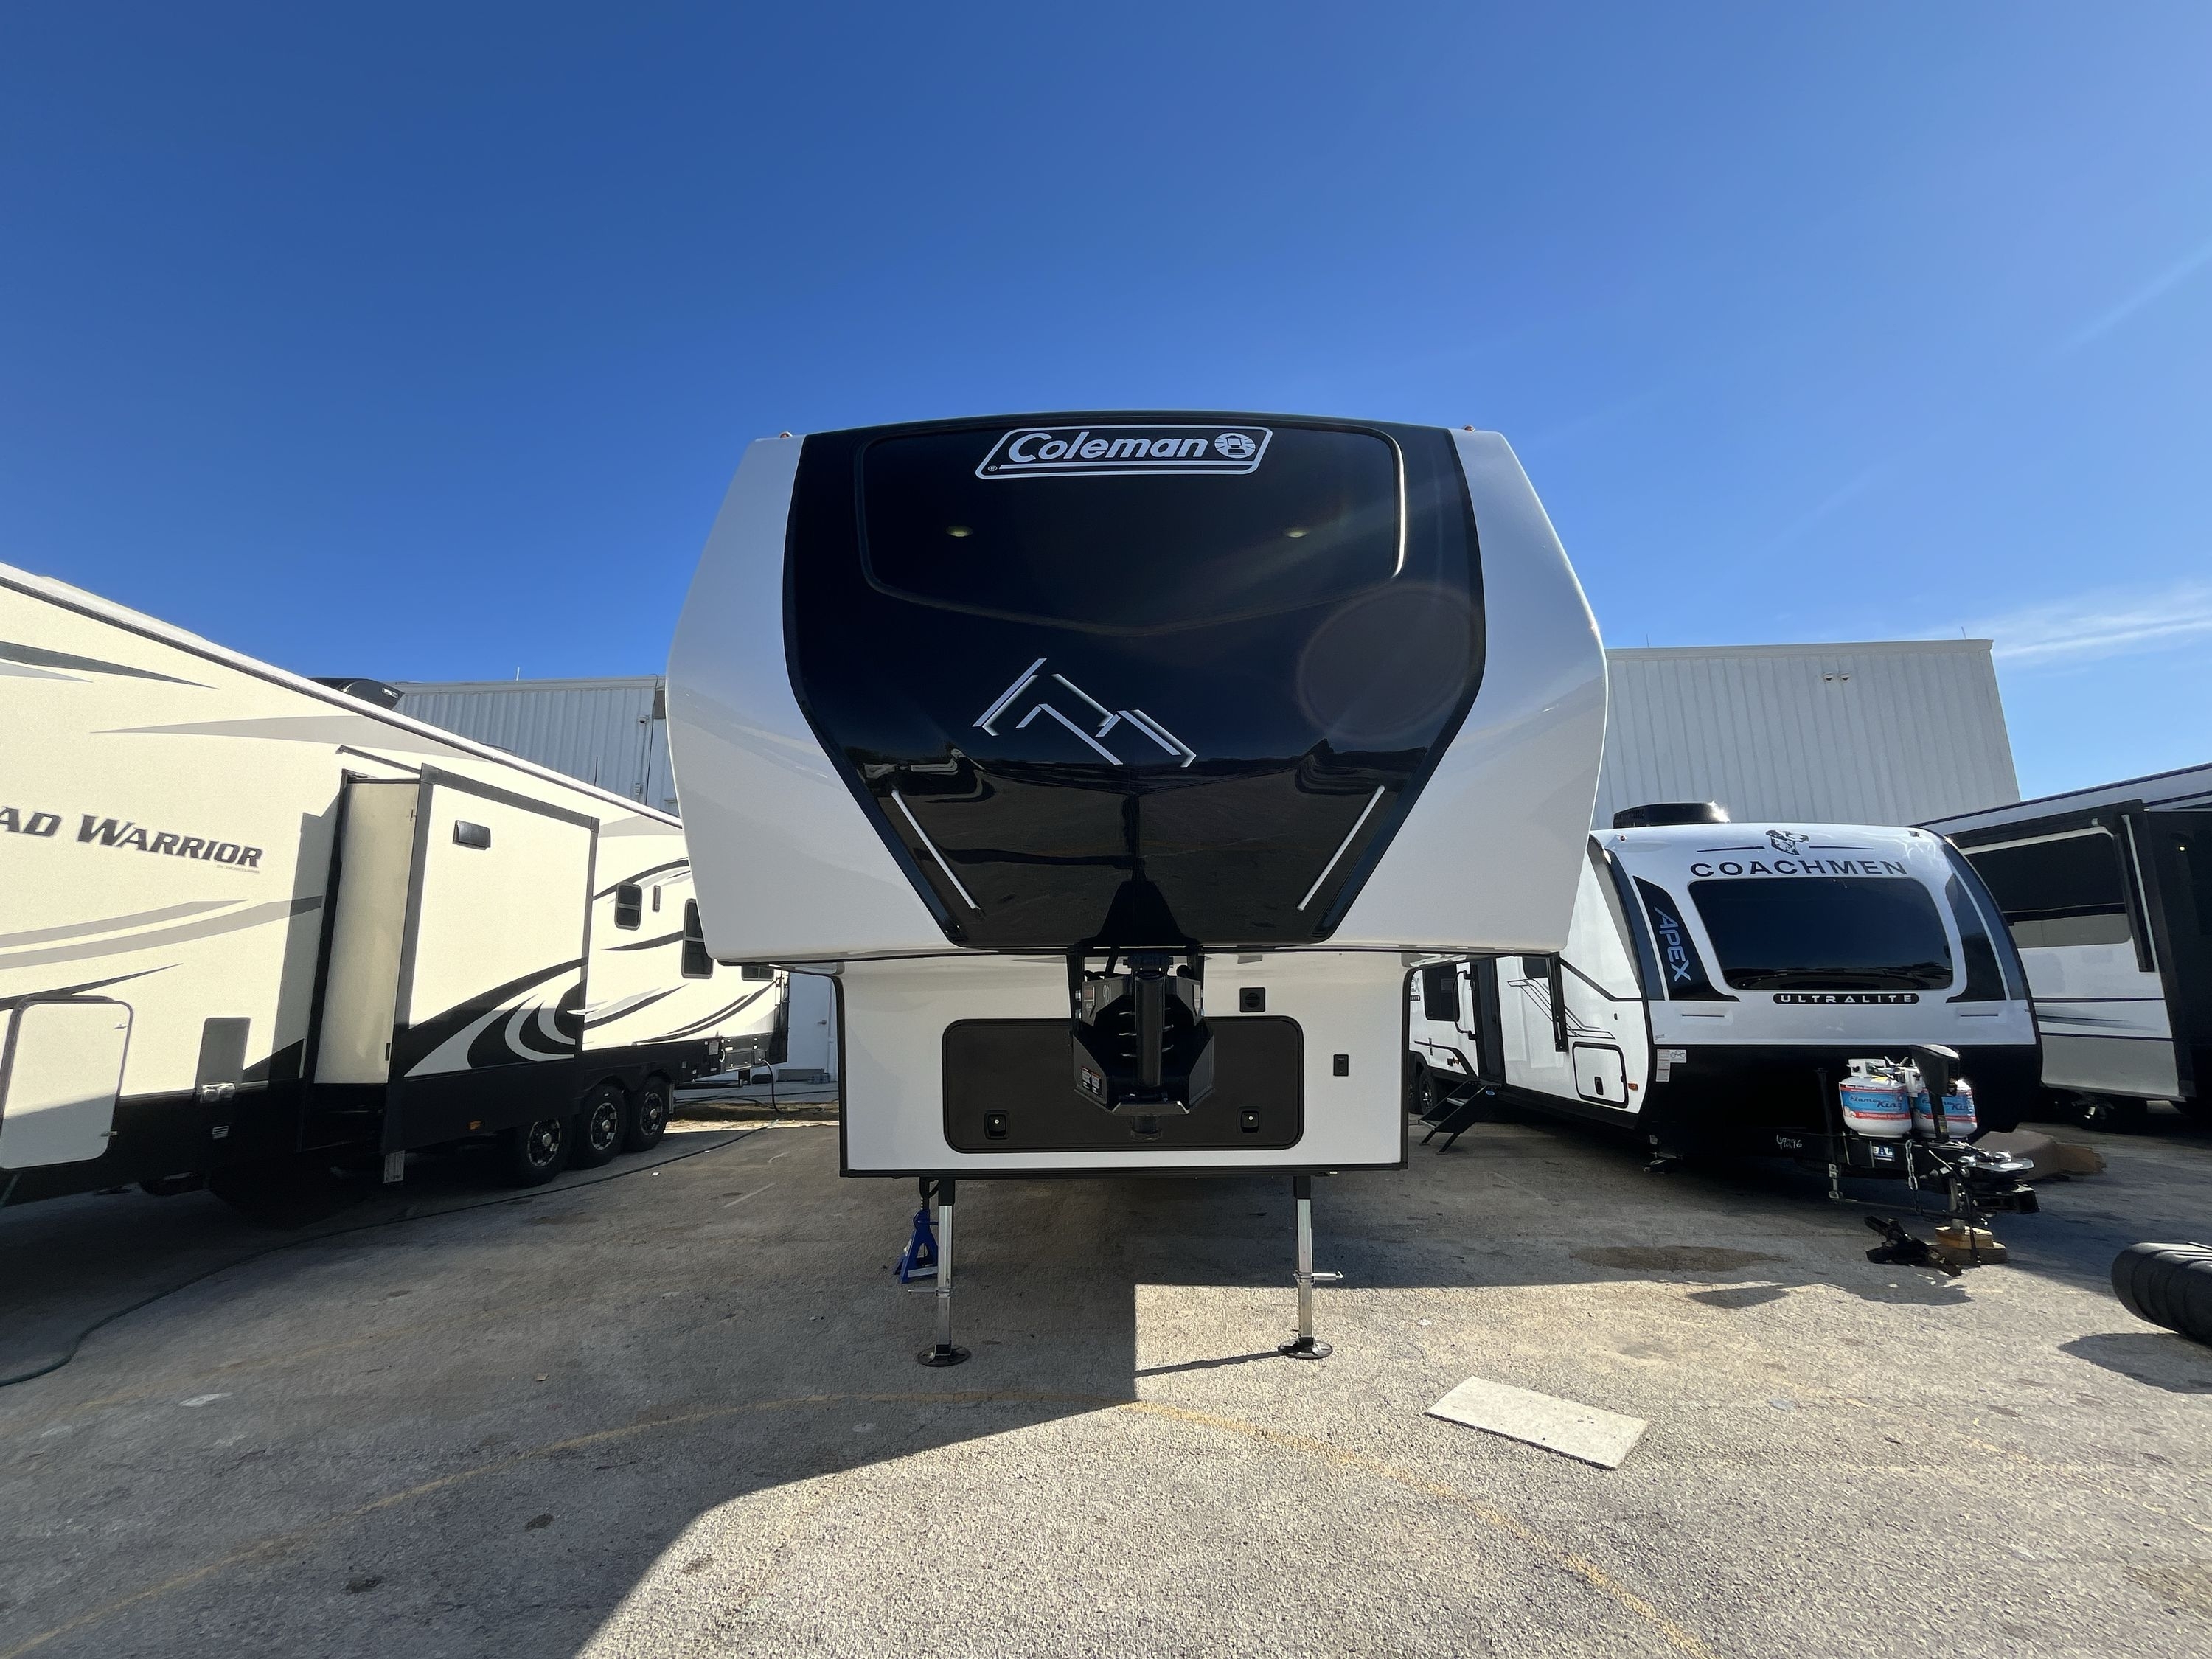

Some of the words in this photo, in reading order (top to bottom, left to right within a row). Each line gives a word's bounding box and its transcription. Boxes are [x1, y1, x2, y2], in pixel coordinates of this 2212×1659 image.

[1007, 431, 1209, 462] Coleman
[76, 814, 263, 868] WARRIOR
[1690, 860, 1908, 877] COACHMEN
[1654, 906, 1691, 982] APEX
[1780, 995, 1912, 1003] ULTRALITE
[1877, 1099, 1902, 1111] King
